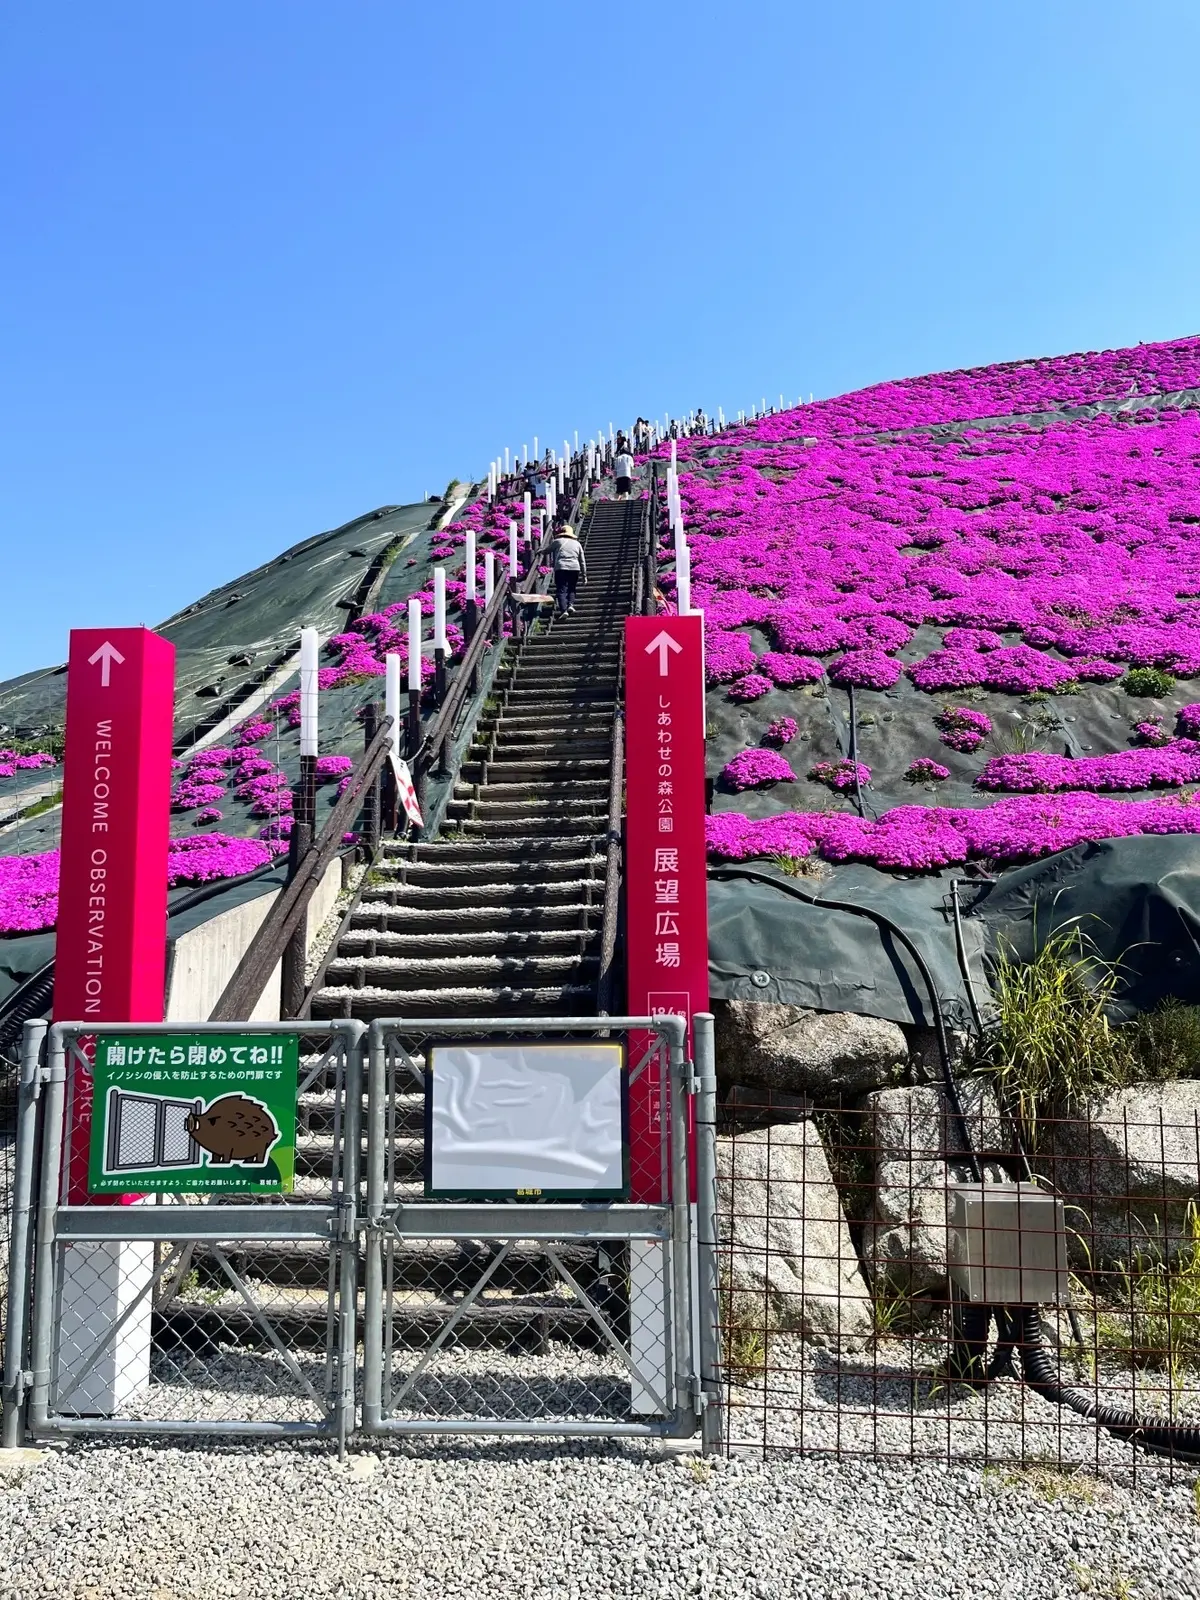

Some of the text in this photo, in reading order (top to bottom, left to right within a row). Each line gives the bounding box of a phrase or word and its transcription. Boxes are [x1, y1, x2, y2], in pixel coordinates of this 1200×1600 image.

[92, 719, 112, 833] WELCOME
[657, 694, 674, 833] しあわせの森公園
[85, 848, 107, 1013] OBSERVATION
[654, 847, 681, 968] 展望広場
[106, 1046, 283, 1066] 開けたら閉めてね!!
[106, 1070, 283, 1081] イノシシの侵入を防止するための門扉です
